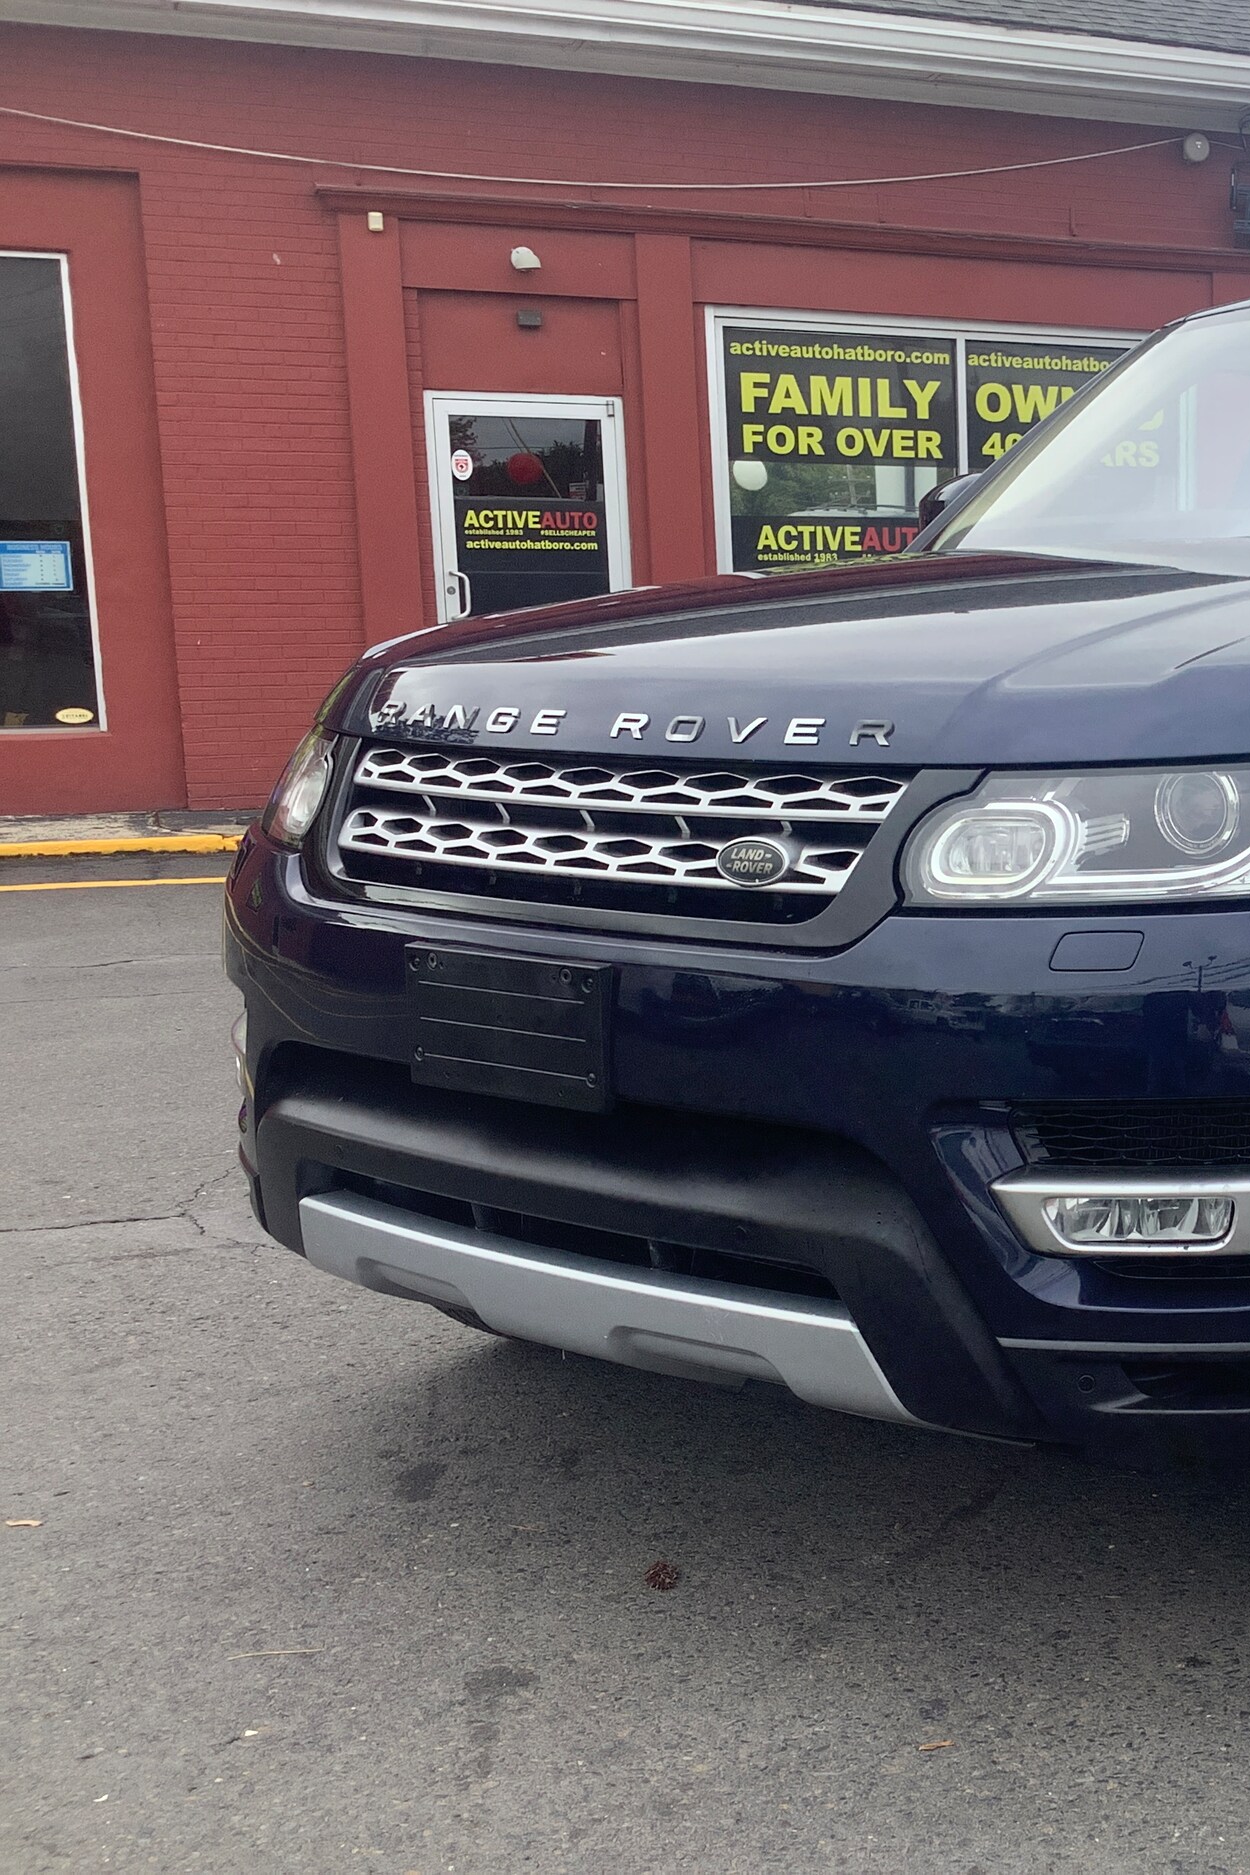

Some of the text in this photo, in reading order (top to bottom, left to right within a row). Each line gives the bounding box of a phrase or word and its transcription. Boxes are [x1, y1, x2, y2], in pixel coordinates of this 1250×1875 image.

[729, 339, 950, 366] activeautohatboro.com
[967, 352, 1113, 373] activeautohatbo
[739, 371, 942, 420] FAMILY
[742, 423, 826, 456] FOR
[836, 427, 943, 460] OVER
[982, 432, 1025, 460] 4
[463, 509, 598, 529] ACTIVEAUTO
[465, 538, 599, 551] activeautohatboro.com
[756, 524, 919, 552] ACTIVEAUT
[757, 552, 839, 563] established 1983
[376, 700, 567, 736] RANGE
[609, 711, 896, 747] ROVER
